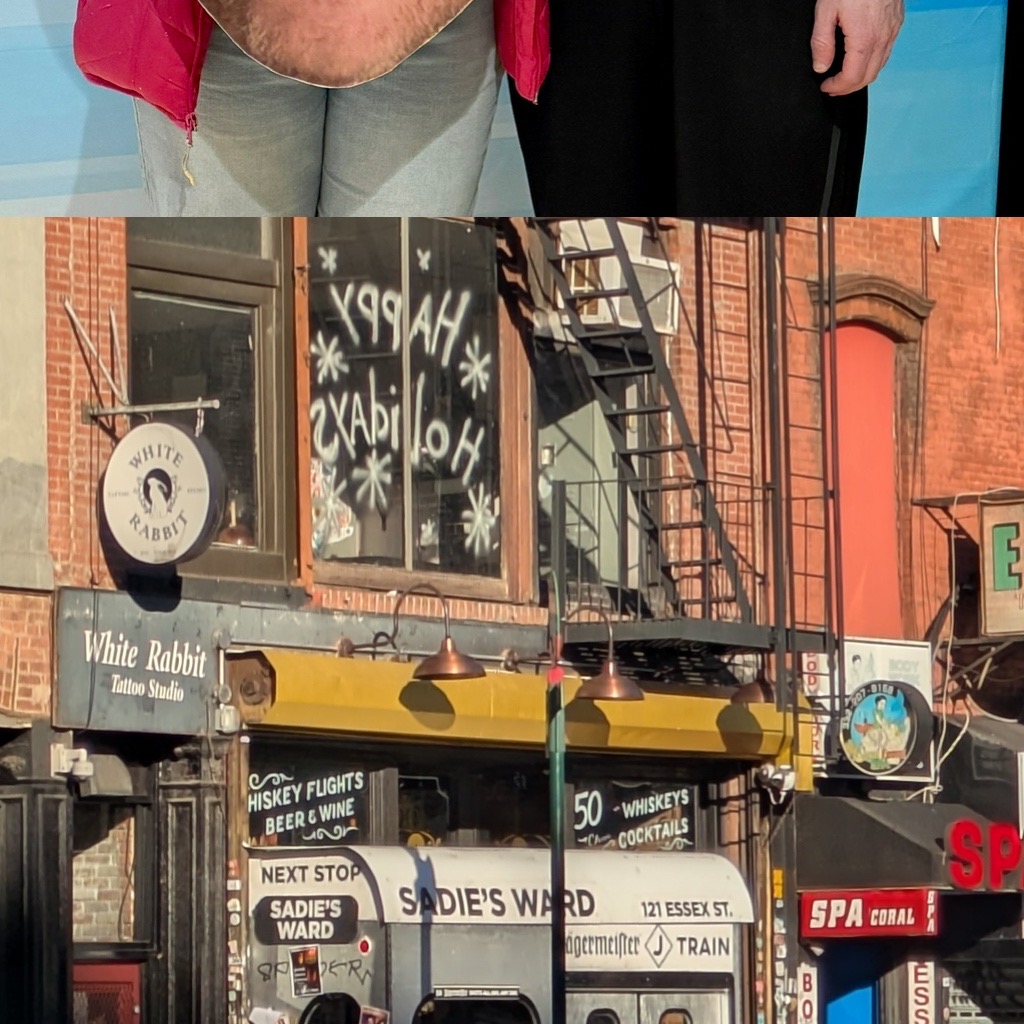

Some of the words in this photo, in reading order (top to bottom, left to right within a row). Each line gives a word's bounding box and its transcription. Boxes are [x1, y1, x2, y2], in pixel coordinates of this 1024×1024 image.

[129, 443, 184, 469] WHITE
[129, 509, 188, 542] RABBIT
[84, 630, 138, 668] White
[145, 639, 207, 678] Rabbit
[112, 674, 145, 696] Tattoo
[148, 678, 184, 702] Studio
[248, 783, 302, 813] HISKEY
[306, 771, 364, 801] FLIGHTS
[265, 810, 306, 836] BEER
[308, 809, 317, 825] &
[319, 797, 355, 823] WINE
[574, 790, 603, 830] 50
[621, 788, 690, 819] WHISKEYS
[618, 817, 689, 849] COCKTAILS
[261, 865, 309, 884] NEXT
[314, 864, 362, 882] STOP
[269, 898, 342, 919] SADIE'S
[398, 886, 507, 917] SADIE'S
[641, 901, 662, 917] 121
[665, 901, 710, 917] ESSEX
[713, 901, 734, 917] ST.
[809, 898, 863, 929] SPA
[870, 907, 916, 926] CORAL
[926, 890, 936, 933] SPA
[276, 920, 335, 940] WARD
[565, 931, 641, 959] ägermeister
[653, 934, 664, 956] J
[676, 936, 730, 956] TRAIN
